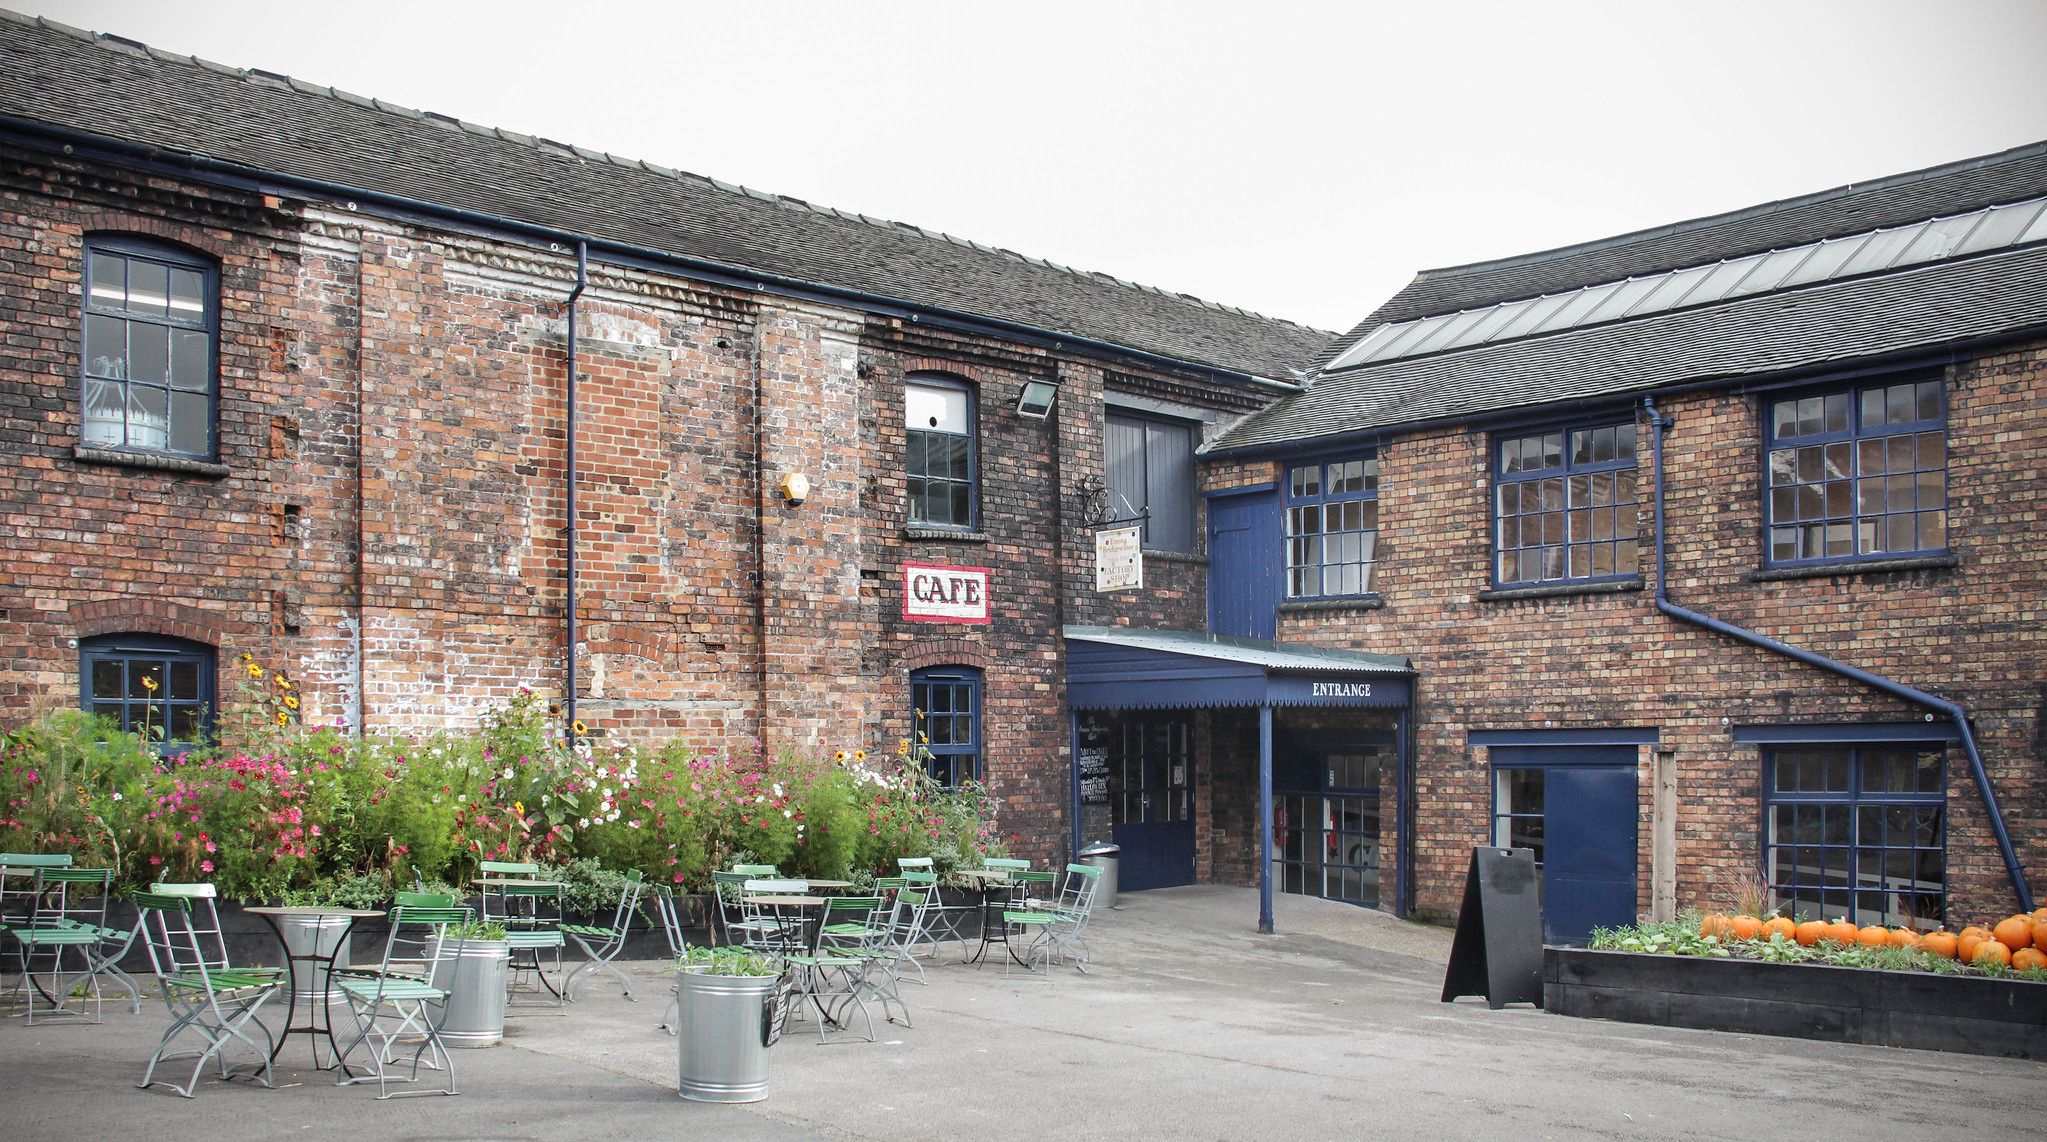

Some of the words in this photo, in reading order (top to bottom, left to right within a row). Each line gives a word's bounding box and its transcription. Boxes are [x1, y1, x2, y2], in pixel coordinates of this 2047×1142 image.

[1110, 574, 1129, 583] SHOP
[913, 574, 981, 606] CAFE
[1313, 682, 1371, 697] ENTRANCE
